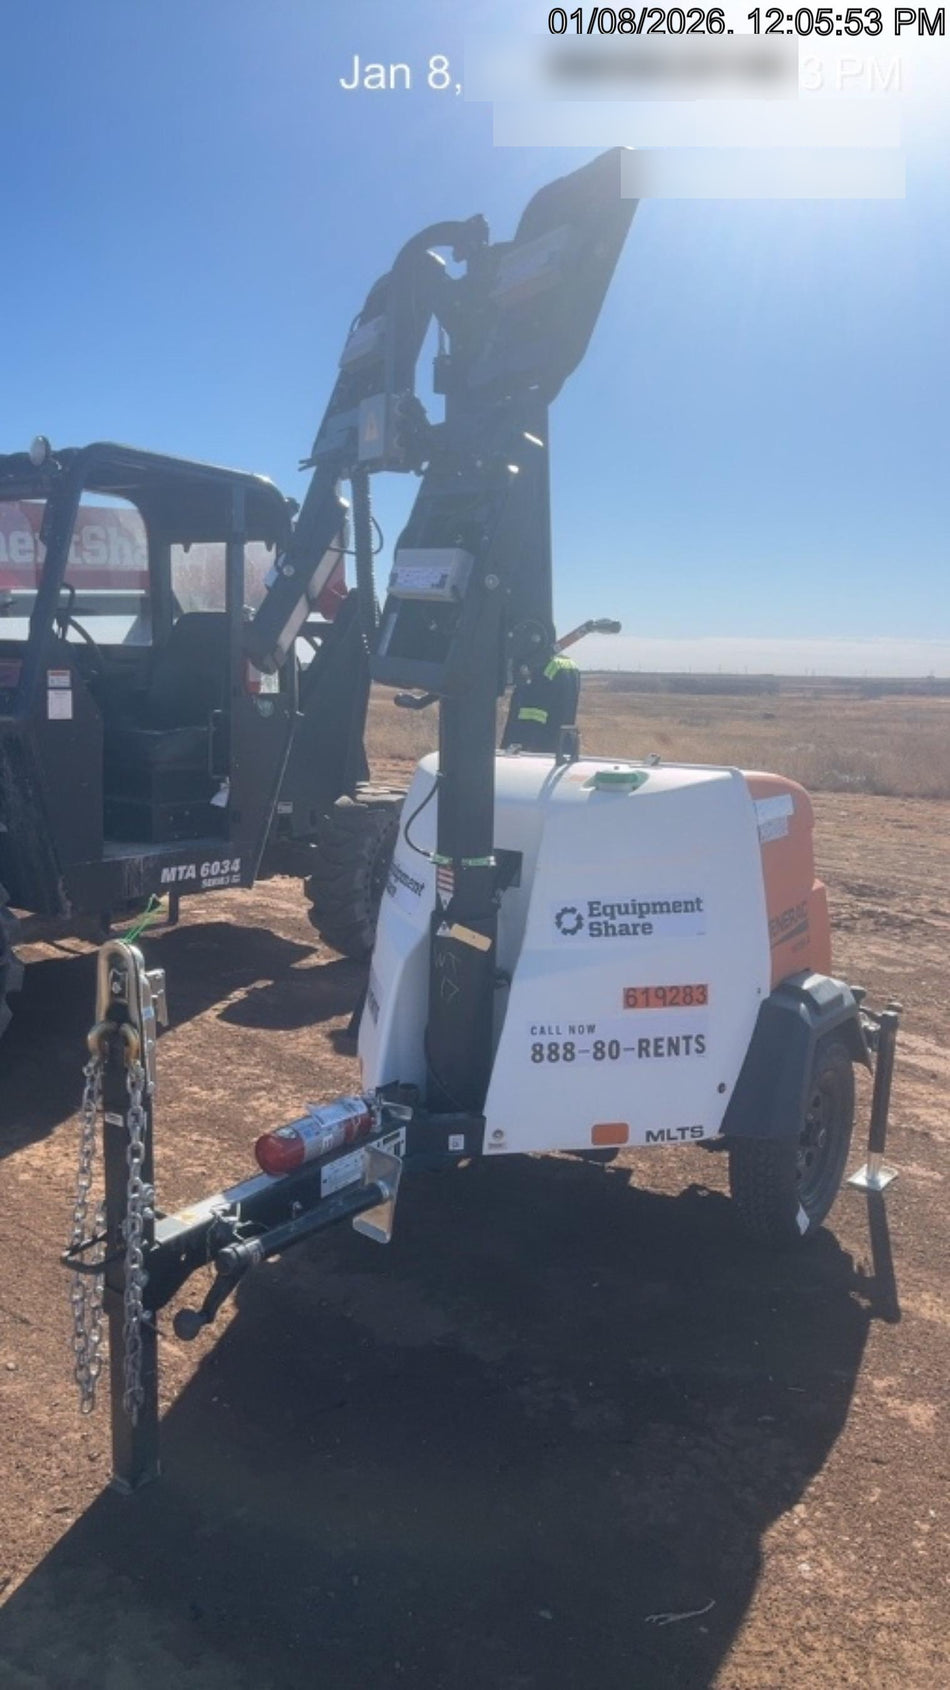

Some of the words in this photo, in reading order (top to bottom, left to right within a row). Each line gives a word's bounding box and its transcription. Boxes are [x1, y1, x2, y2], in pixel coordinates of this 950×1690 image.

[161, 864, 197, 883] MTA
[200, 858, 241, 878] 6034
[587, 898, 703, 920] Equipment
[589, 920, 653, 937] Share
[624, 984, 707, 1008] 619283
[530, 1025, 563, 1036] CALL
[569, 1024, 596, 1035] NOW
[531, 1034, 706, 1063] 888-80-RENTS
[645, 1125, 704, 1142] MLTS
